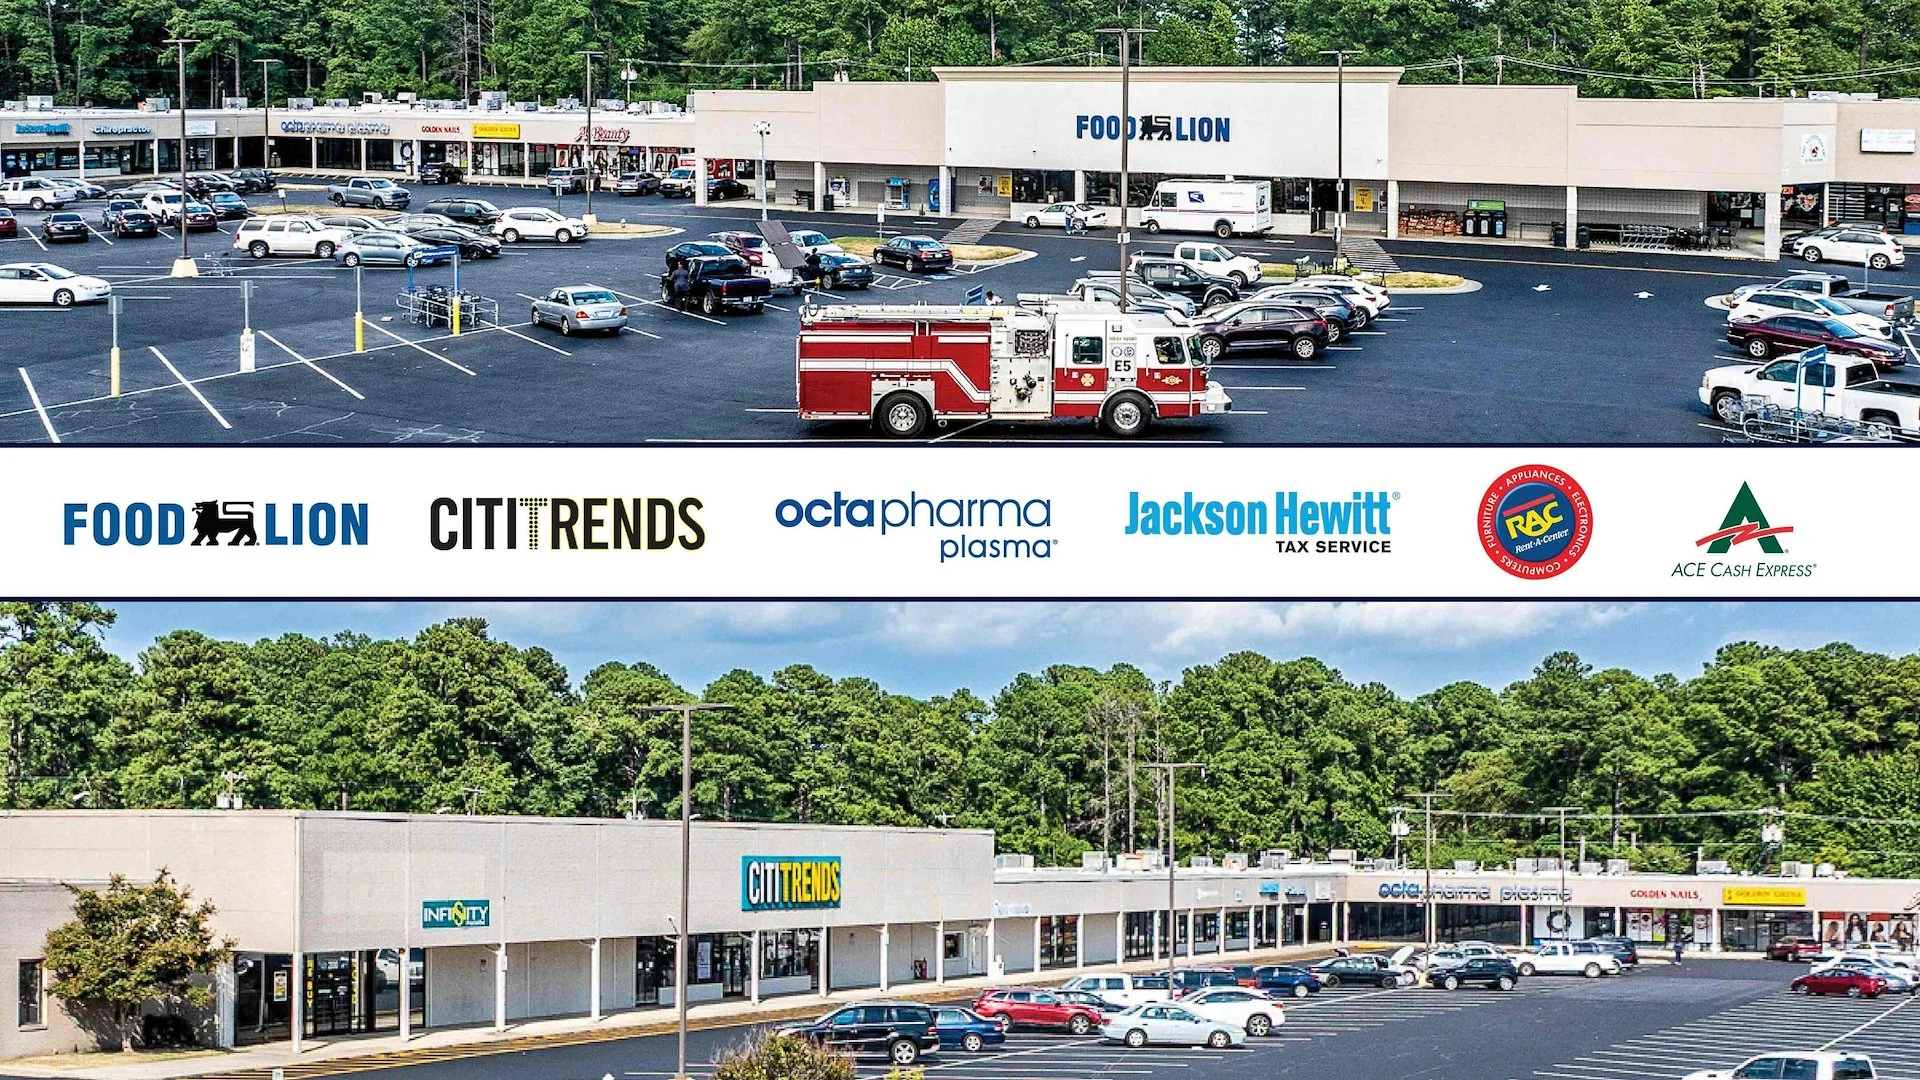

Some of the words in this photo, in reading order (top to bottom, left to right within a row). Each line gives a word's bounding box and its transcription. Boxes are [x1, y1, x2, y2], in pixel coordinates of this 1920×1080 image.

[591, 125, 631, 144] Beauty
[1076, 115, 1137, 140] FOOD
[1176, 117, 1231, 142] LION
[1114, 360, 1131, 372] E5
[1630, 890, 1667, 899] GOLDEN
[1670, 890, 1699, 900] NAILS
